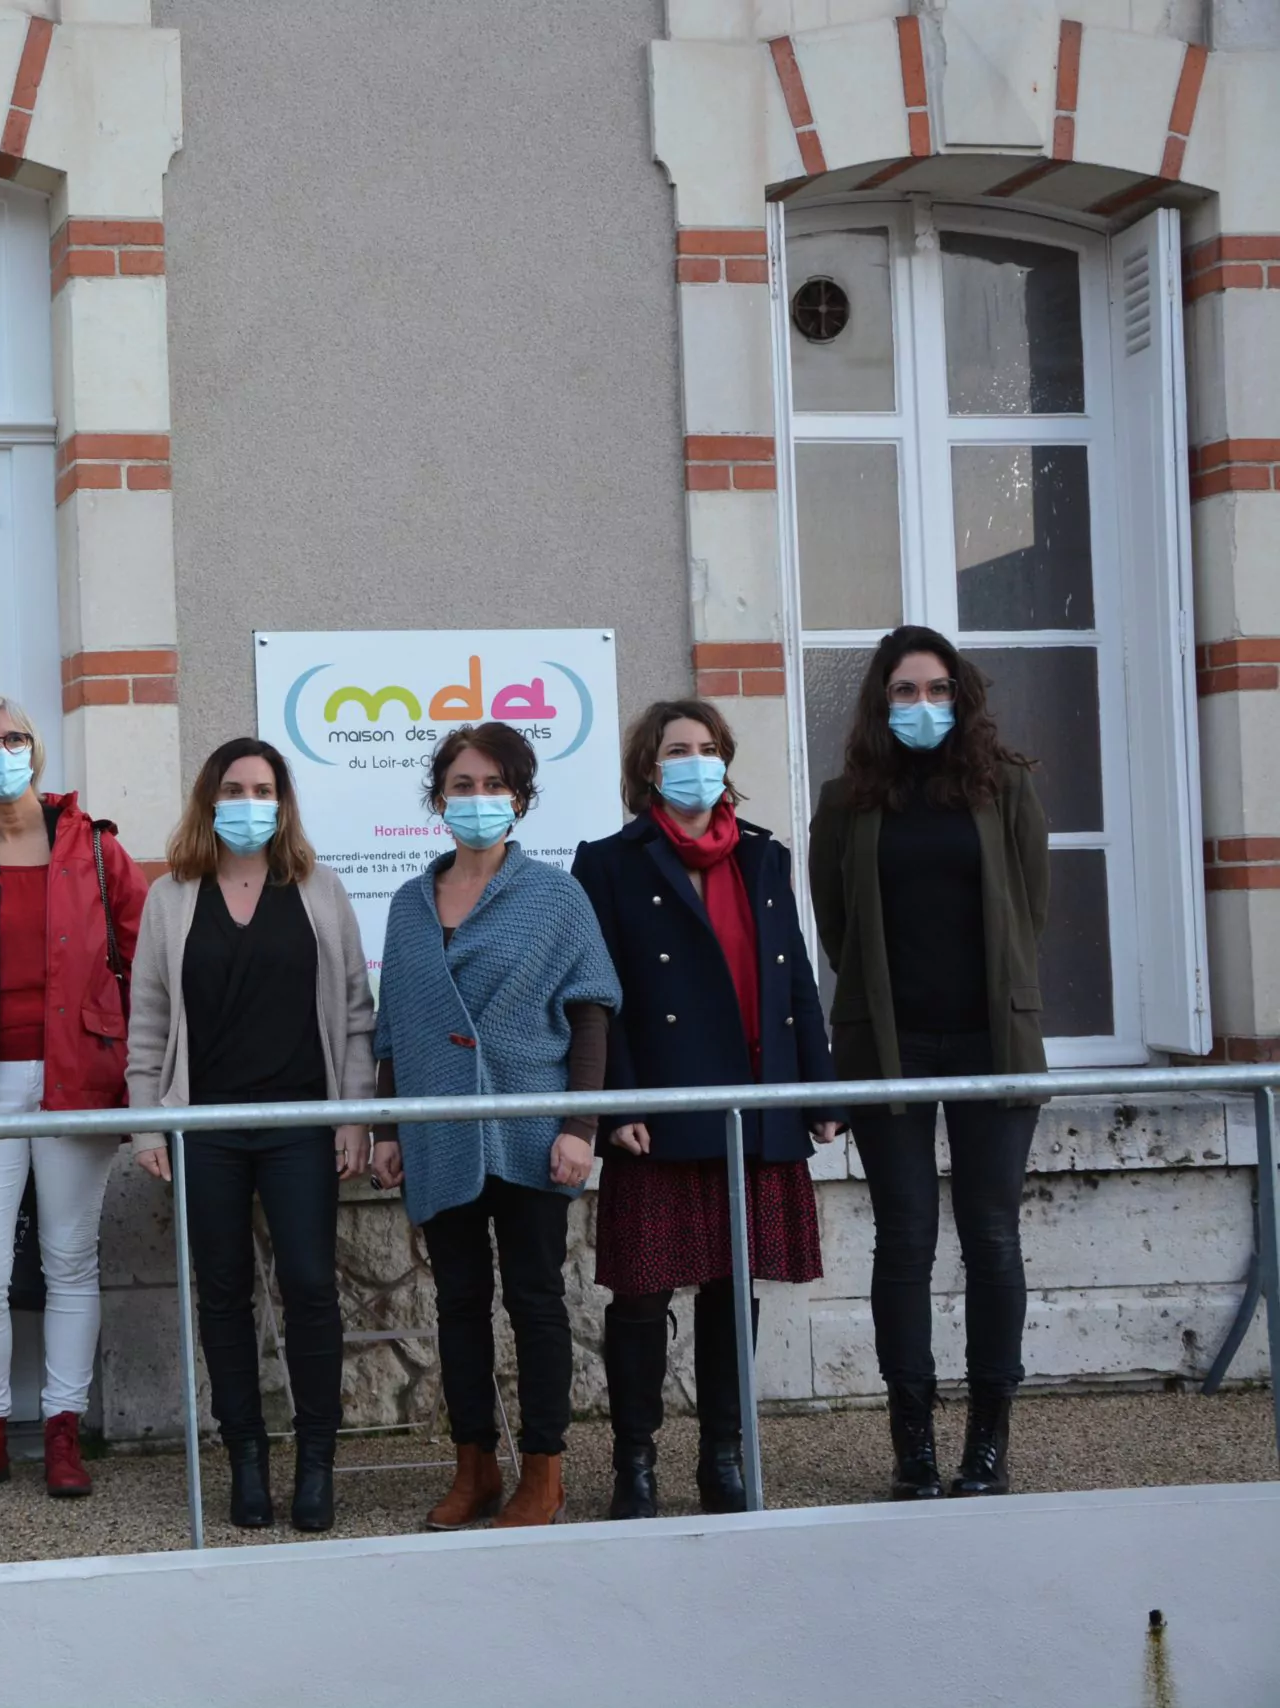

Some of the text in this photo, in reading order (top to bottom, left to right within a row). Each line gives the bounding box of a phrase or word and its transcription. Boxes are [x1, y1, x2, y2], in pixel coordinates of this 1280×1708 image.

[324, 655, 557, 722] mda
[328, 730, 394, 742] maison
[405, 725, 437, 741] des
[348, 754, 431, 769] du Loir-et-C
[374, 825, 429, 837] Horaires
[409, 849, 421, 859] de
[540, 847, 577, 856] rendez-
[331, 864, 354, 874] eudi
[356, 863, 369, 874] de
[372, 863, 389, 873] 13h
[391, 861, 398, 872] à
[400, 862, 418, 873] 17h
[347, 890, 395, 900] ermanenc
